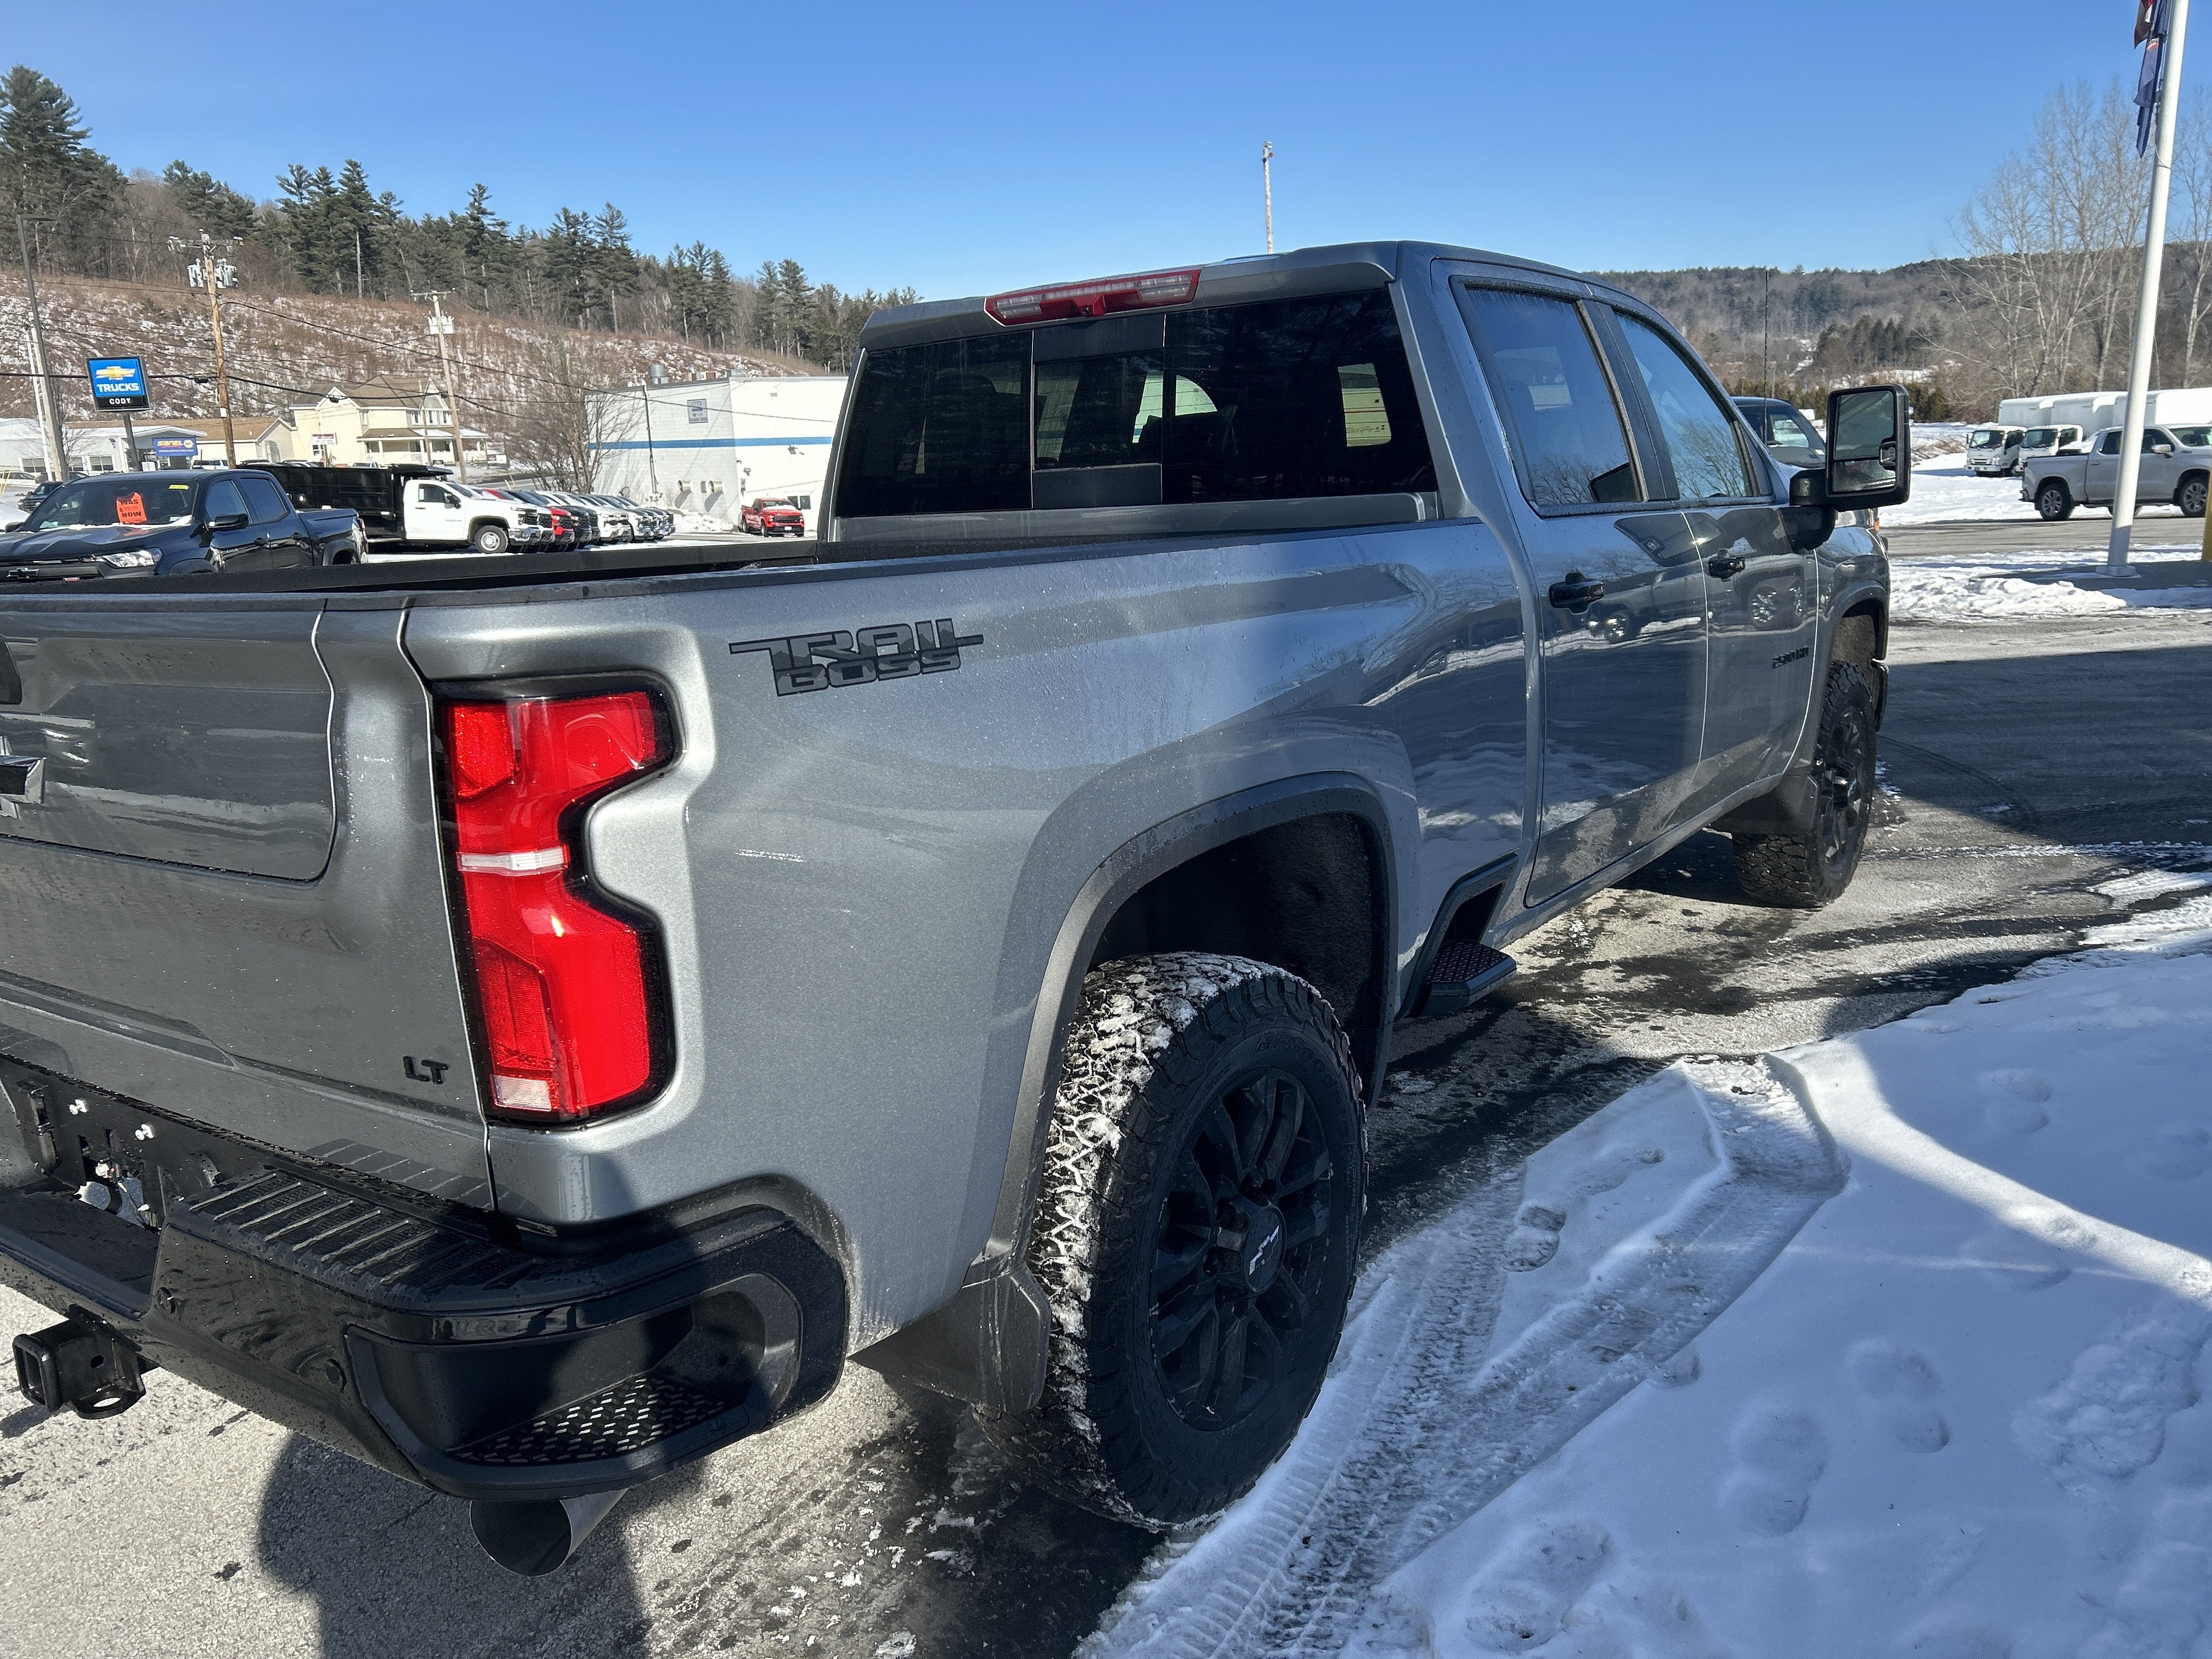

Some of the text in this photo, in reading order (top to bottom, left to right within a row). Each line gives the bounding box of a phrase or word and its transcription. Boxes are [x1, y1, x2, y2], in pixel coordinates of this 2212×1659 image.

[97, 382, 139, 392] TRUCKS
[729, 618, 984, 669] TRAIL
[772, 647, 962, 697] BOSS
[403, 1056, 450, 1085] LT
